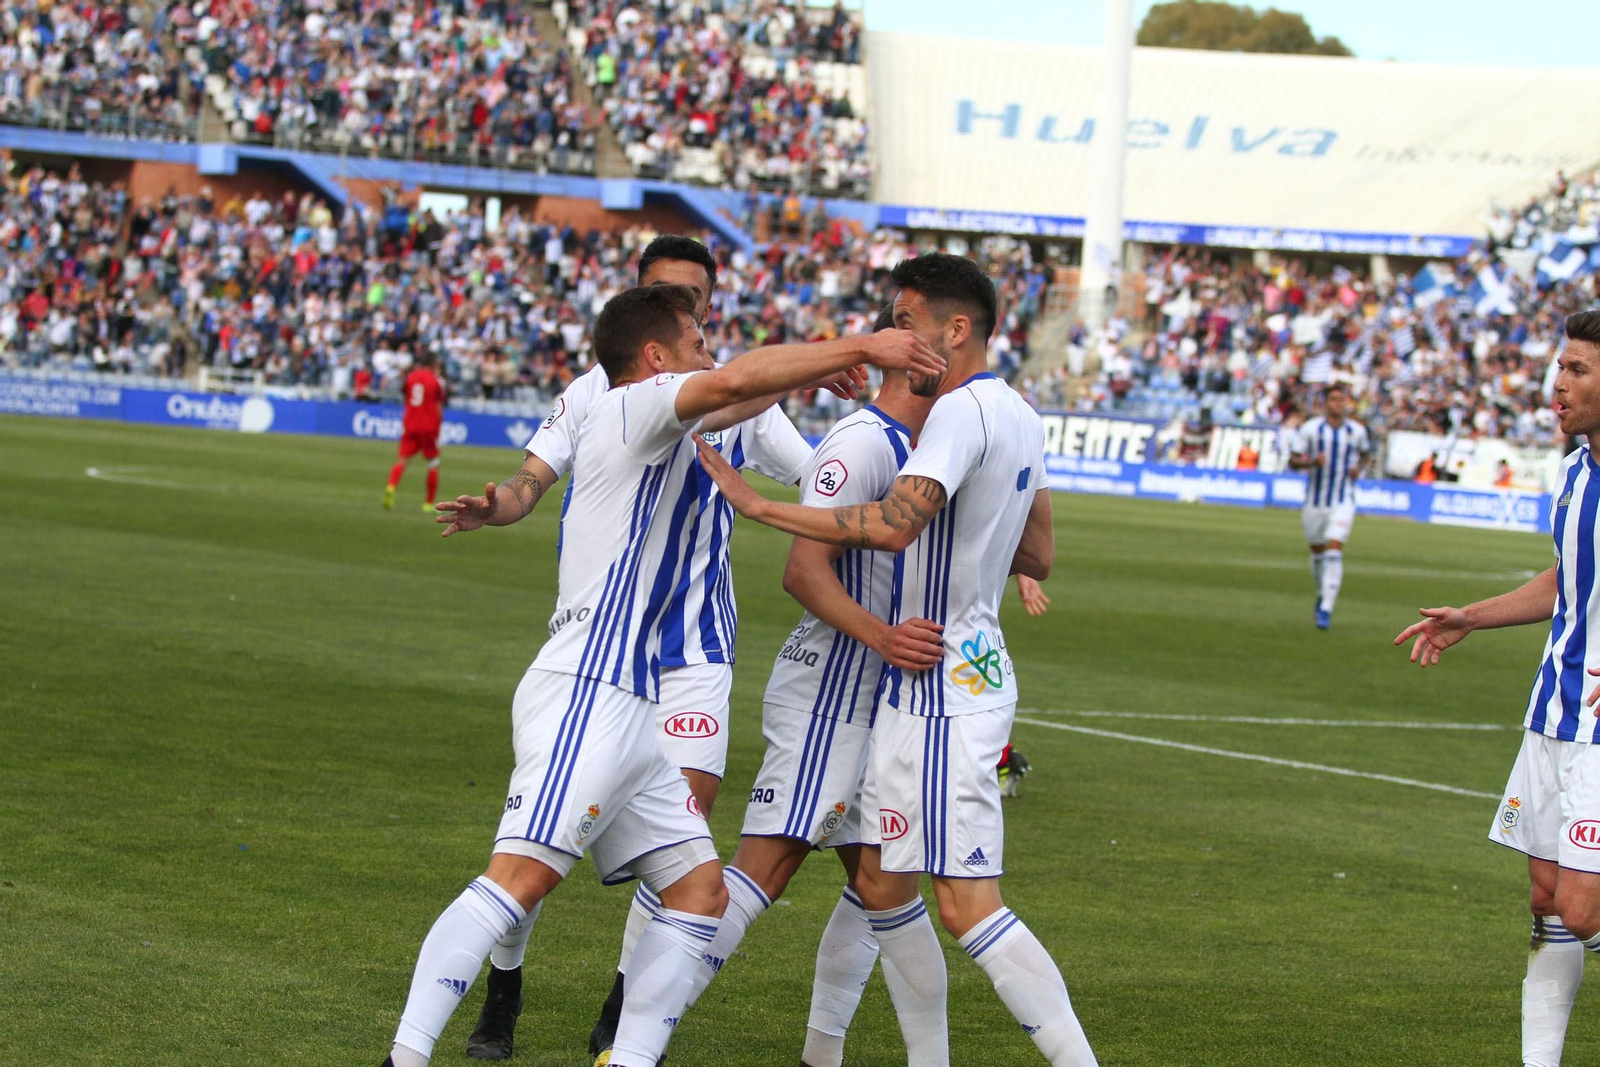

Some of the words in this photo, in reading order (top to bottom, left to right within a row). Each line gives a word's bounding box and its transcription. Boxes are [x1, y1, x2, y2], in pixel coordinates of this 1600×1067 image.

[956, 99, 1338, 157] Huelva
[352, 410, 468, 445] Cruzpo
[673, 717, 711, 734] KIA
[880, 816, 902, 833] IA
